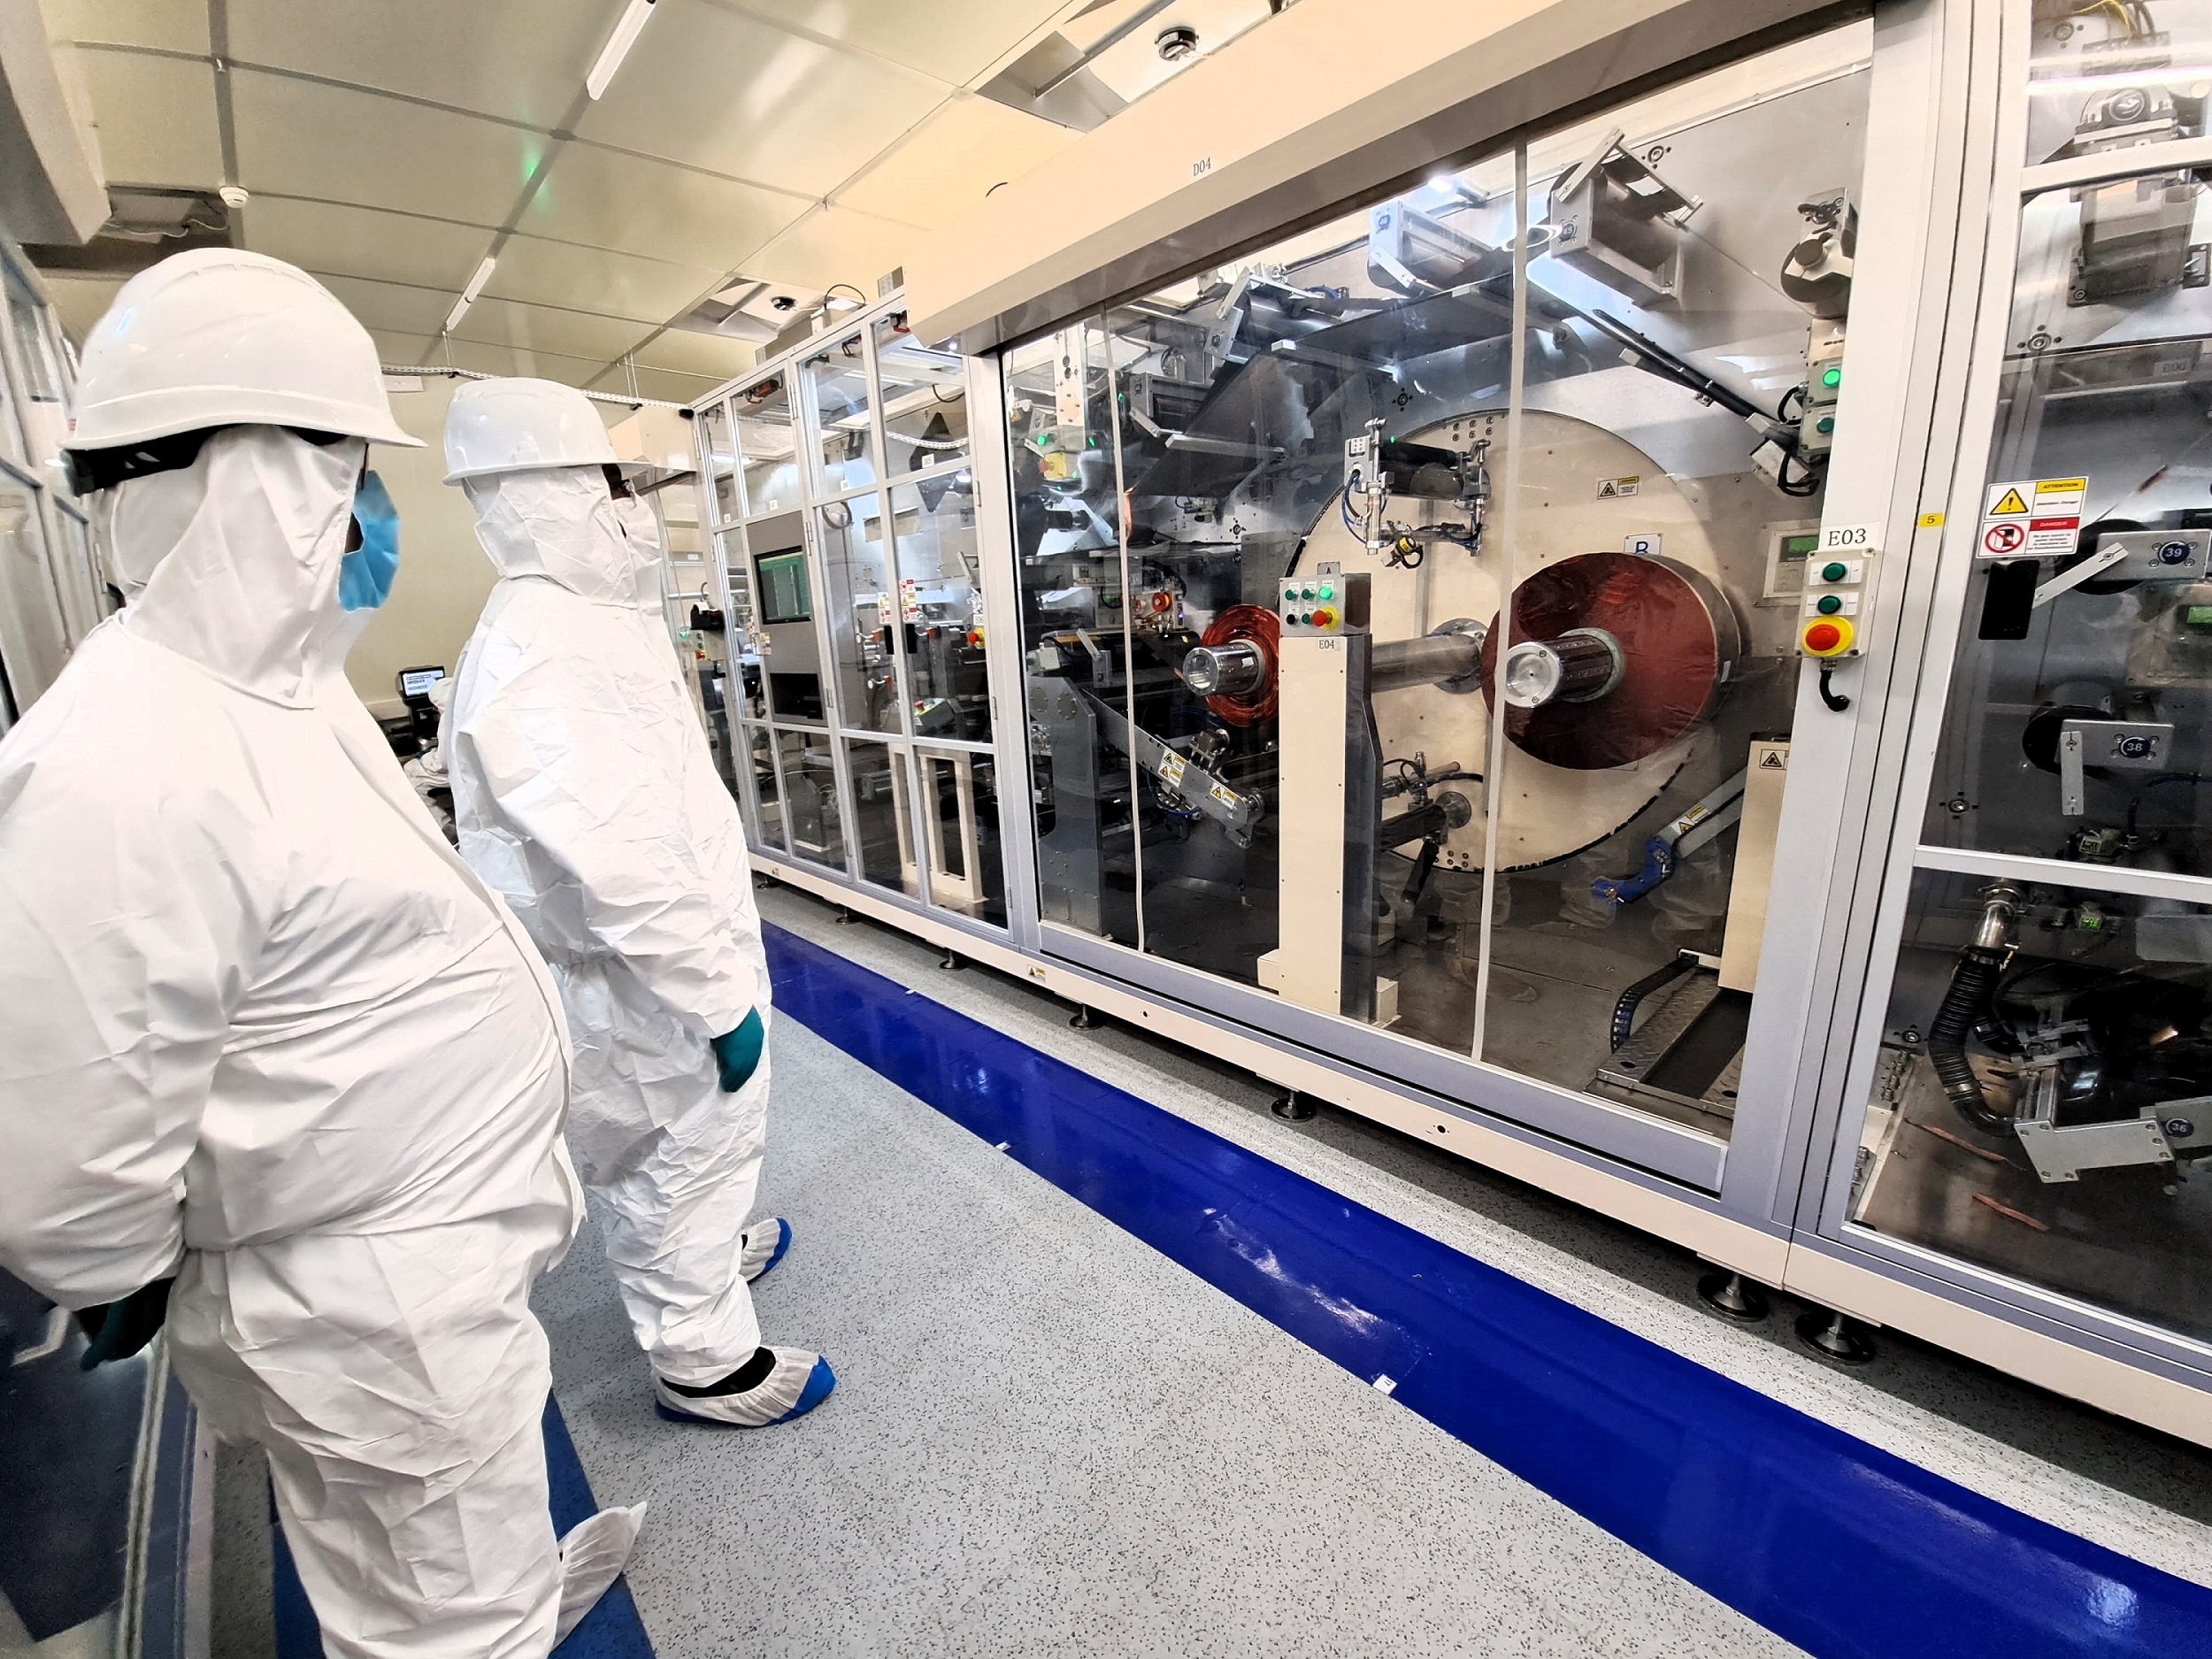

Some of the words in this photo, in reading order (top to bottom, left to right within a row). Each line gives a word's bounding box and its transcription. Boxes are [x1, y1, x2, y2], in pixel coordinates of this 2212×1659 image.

[1193, 156, 1211, 177] D04
[1926, 515, 1935, 524] 5
[1827, 528, 1867, 547] E03
[2165, 548, 2182, 557] 39
[1318, 639, 1334, 649] E04
[2126, 742, 2143, 751] 38
[2171, 1123, 2187, 1133] 36
